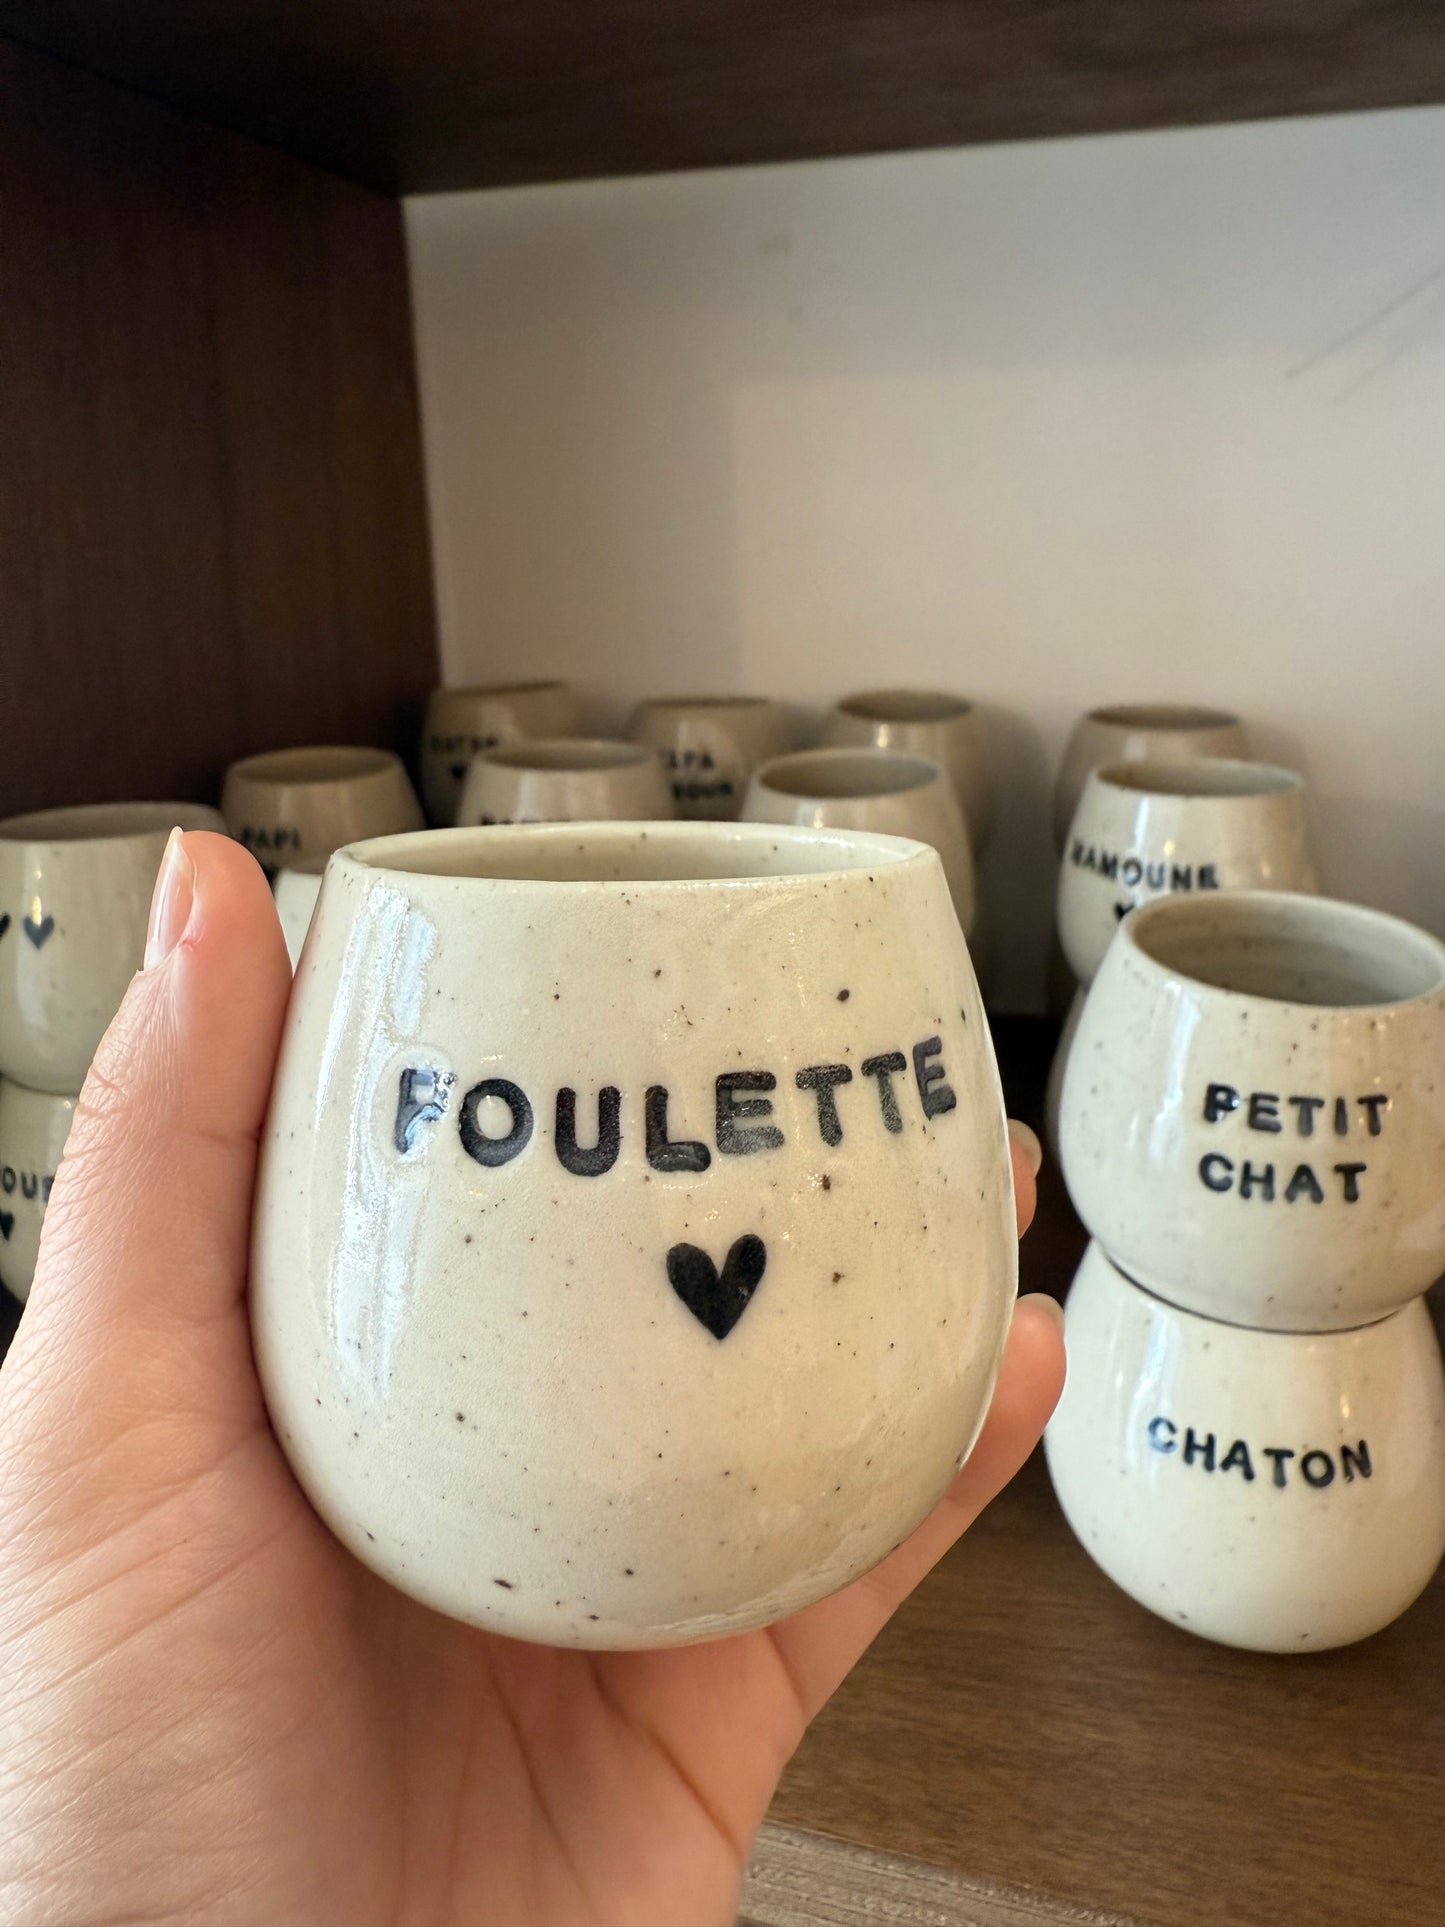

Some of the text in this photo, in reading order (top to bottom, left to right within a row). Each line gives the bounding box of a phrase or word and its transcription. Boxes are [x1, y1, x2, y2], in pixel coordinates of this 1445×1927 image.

[394, 1035, 958, 1178] POULETTE
[1204, 1082, 1388, 1137] PETIT
[1199, 1152, 1368, 1203] CHAT
[1148, 1417, 1374, 1490] CHATON
